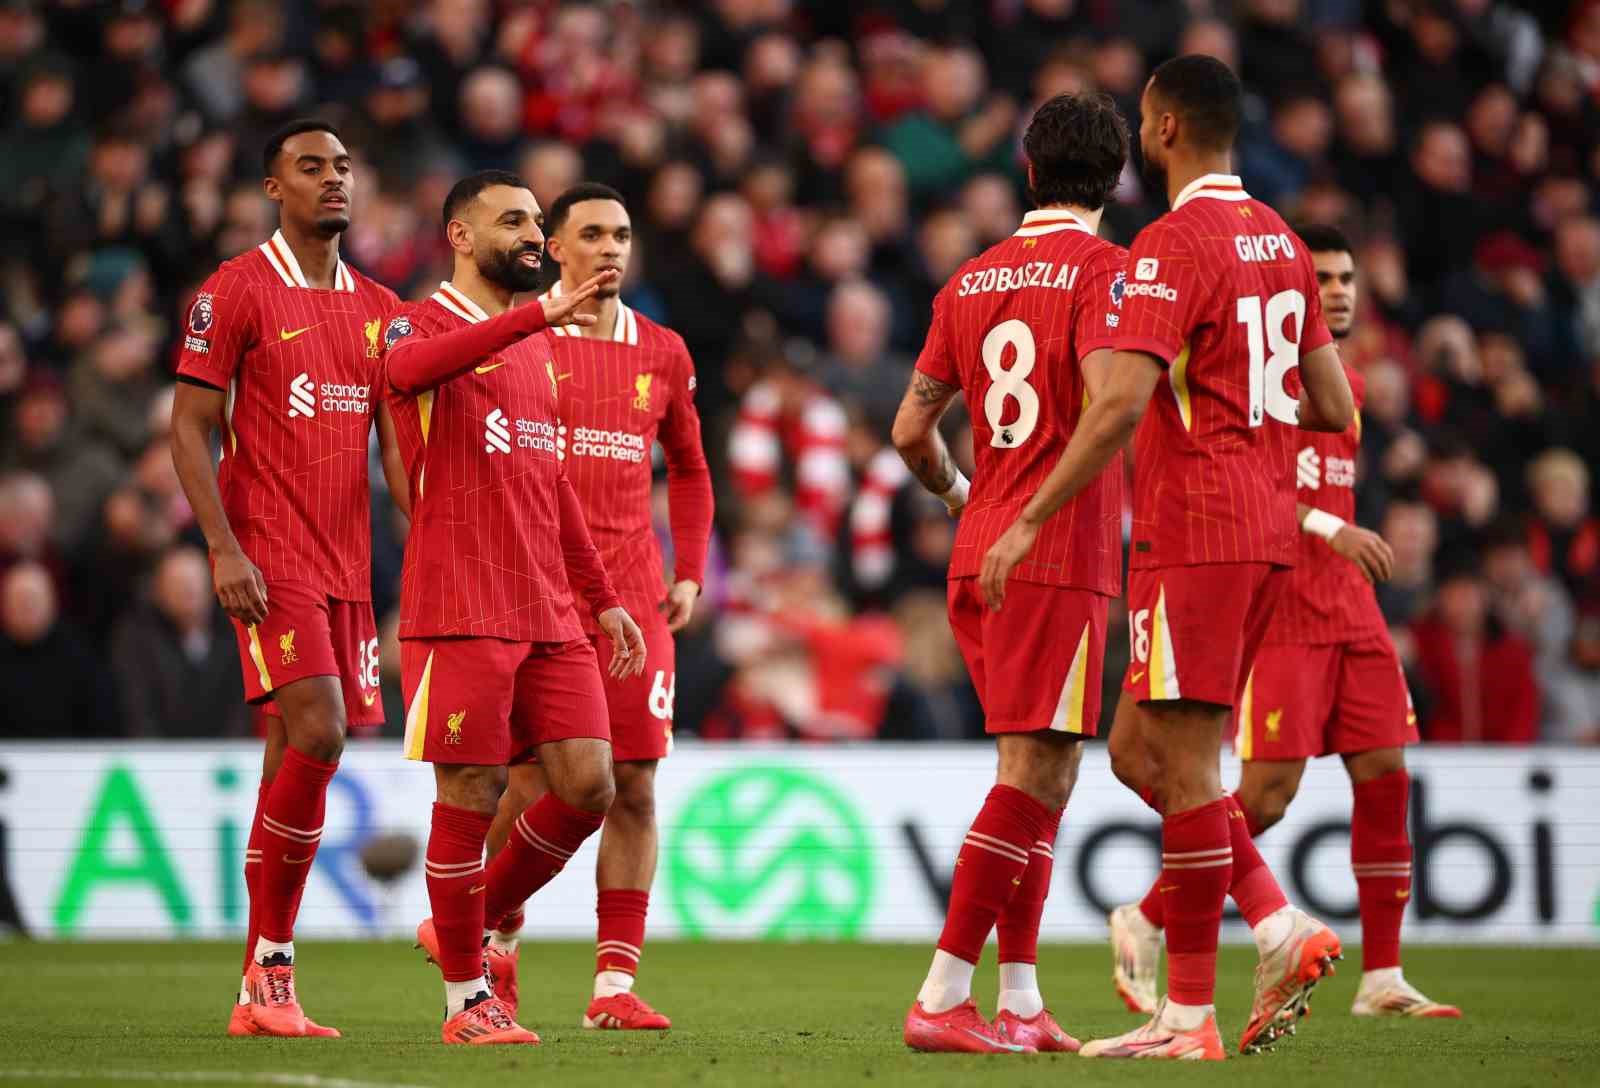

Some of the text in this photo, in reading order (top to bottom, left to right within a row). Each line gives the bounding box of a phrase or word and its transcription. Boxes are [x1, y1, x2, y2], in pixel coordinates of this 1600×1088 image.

[958, 261, 1080, 297] SZOBOSZLAI
[1123, 282, 1178, 302] xpedia
[981, 318, 1040, 449] 8
[1236, 289, 1306, 428] 18
[358, 636, 380, 690] 38
[1128, 608, 1150, 664] 18
[901, 768, 1556, 925] aabi
